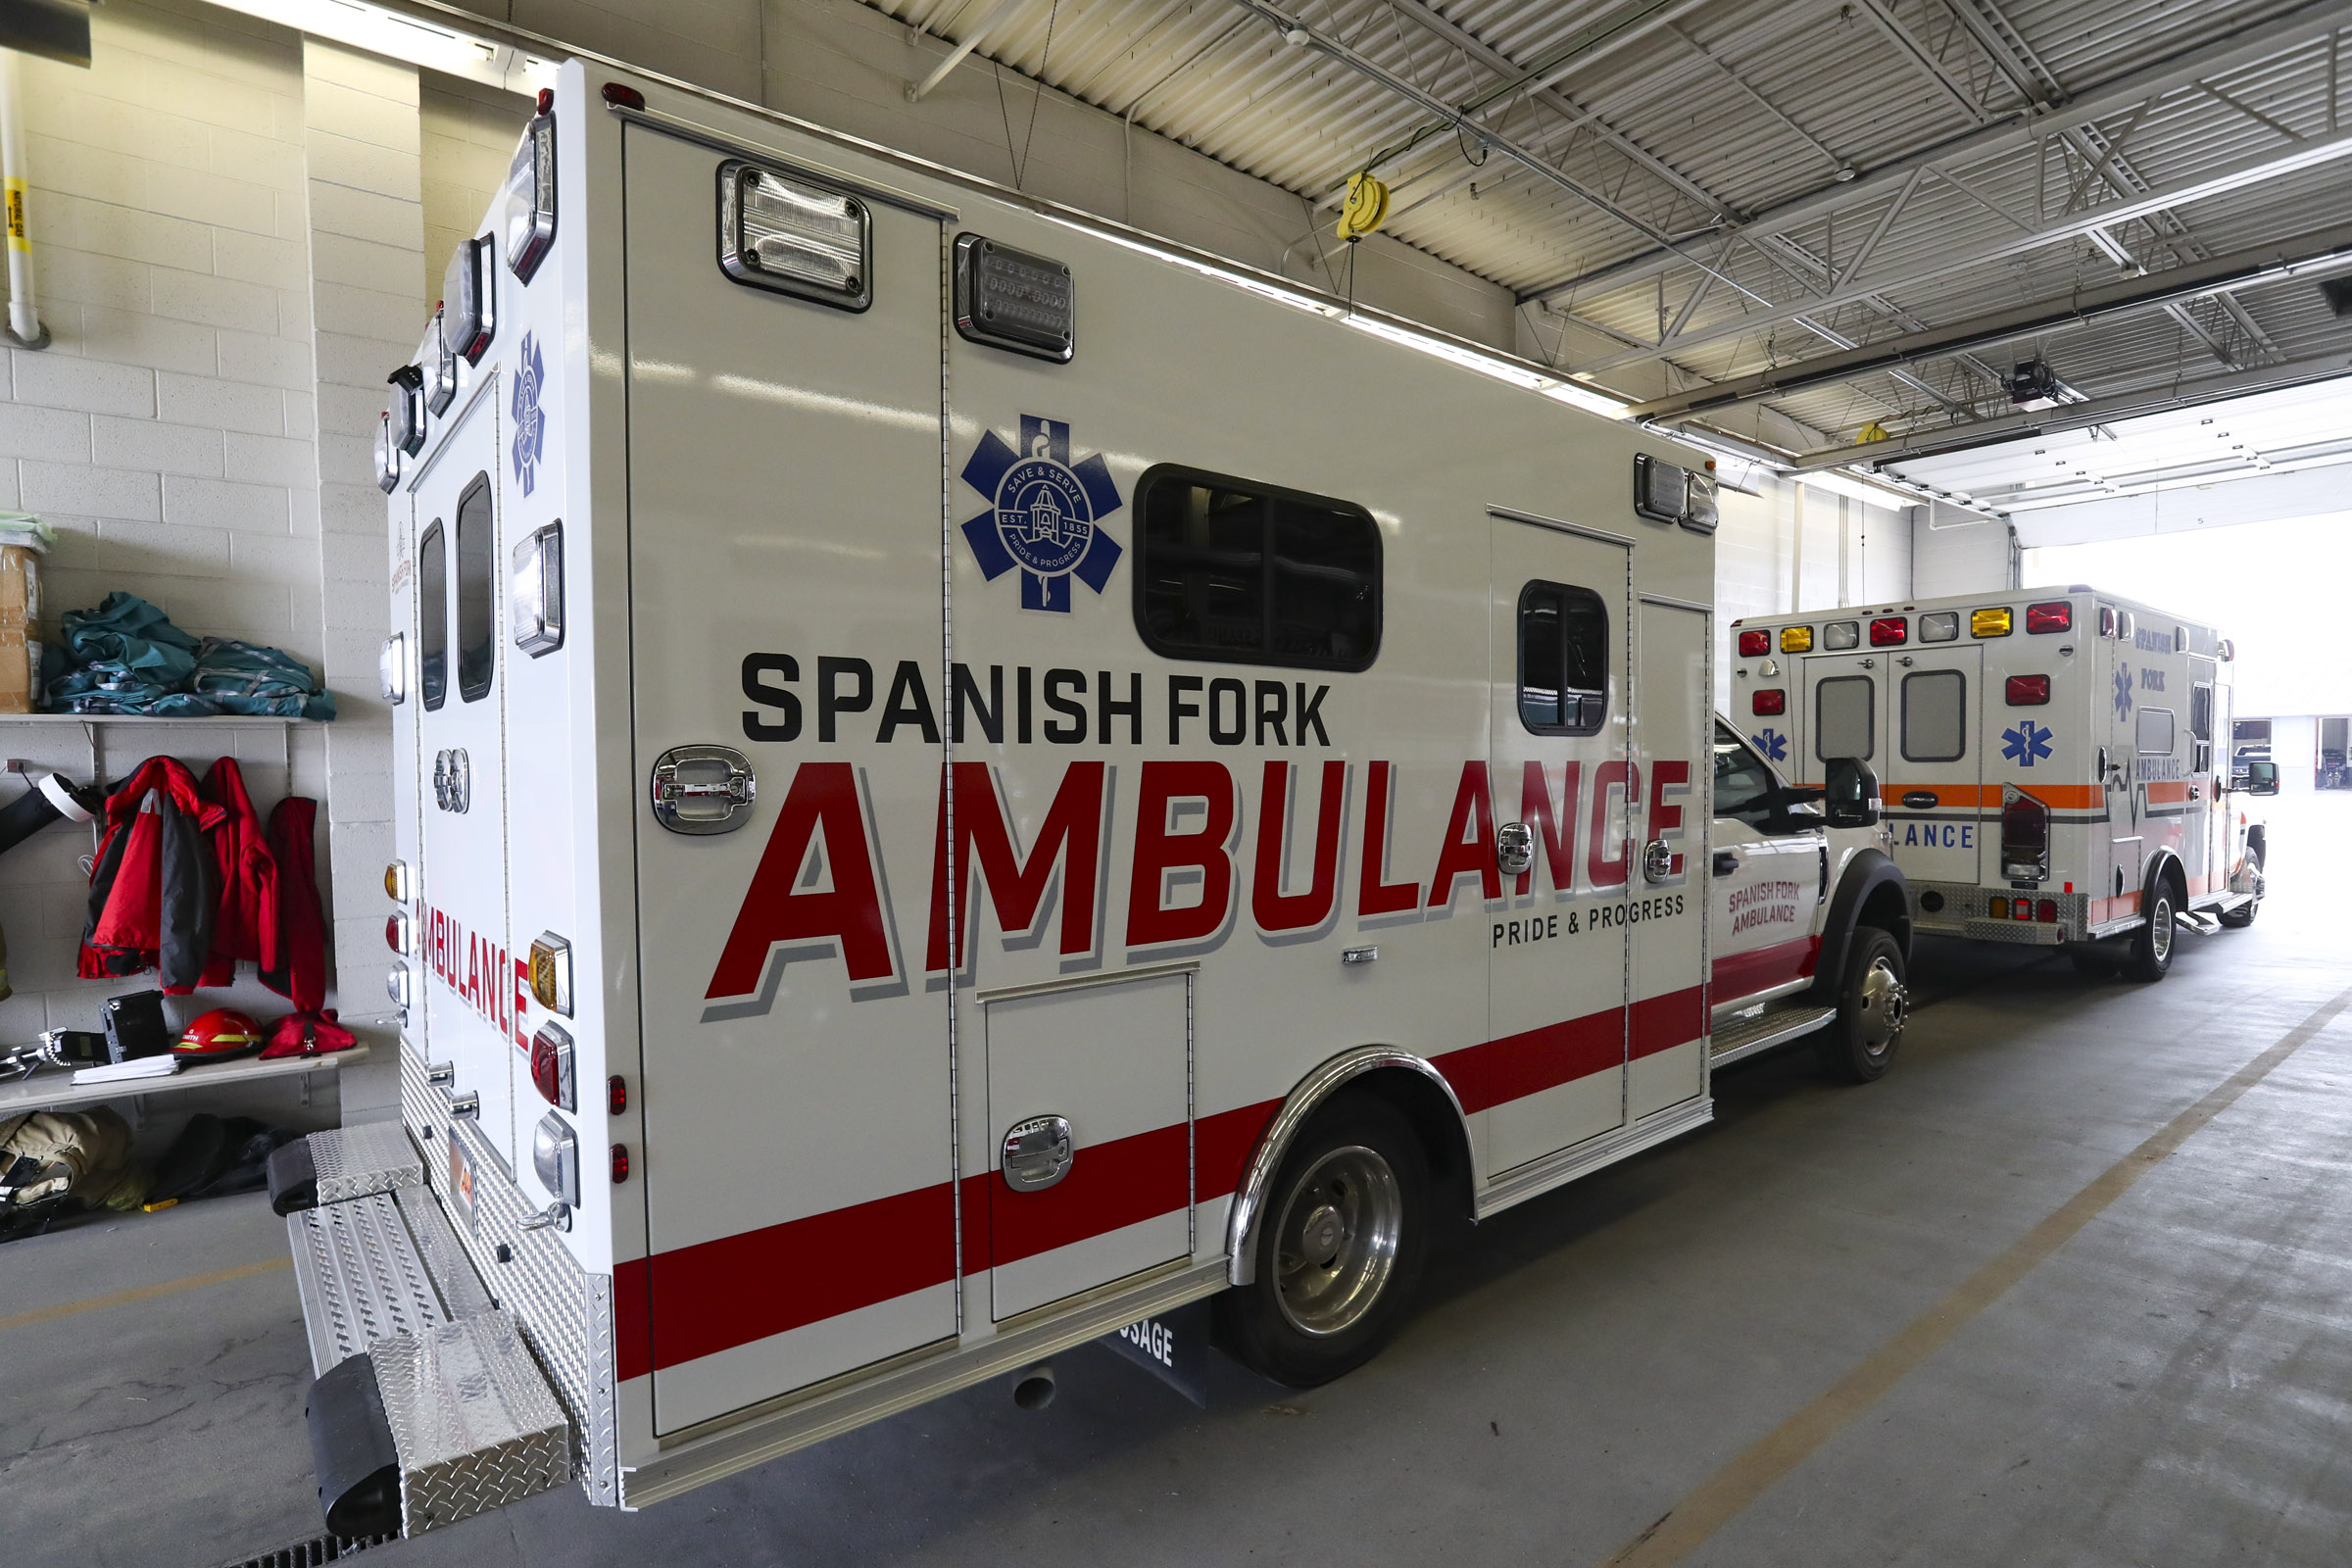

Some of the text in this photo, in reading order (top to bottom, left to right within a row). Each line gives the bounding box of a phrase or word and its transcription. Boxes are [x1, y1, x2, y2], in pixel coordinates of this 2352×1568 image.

[1007, 466, 1081, 504] SAVE & SERVE
[1002, 514, 1088, 535] EST. 1855
[1009, 534, 1081, 567] PRIDE & PROGRESS
[741, 652, 1331, 747] SPANISH FORK
[2135, 759, 2180, 781] AMBULANCE
[705, 760, 1690, 1002] AMBULANCE
[1729, 880, 1799, 913] SPANISH FORK
[1493, 894, 1685, 948] PRIDE & PROGRESS
[1732, 904, 1795, 936] AMBULANCE
[415, 898, 529, 1053] AMBULANCE
